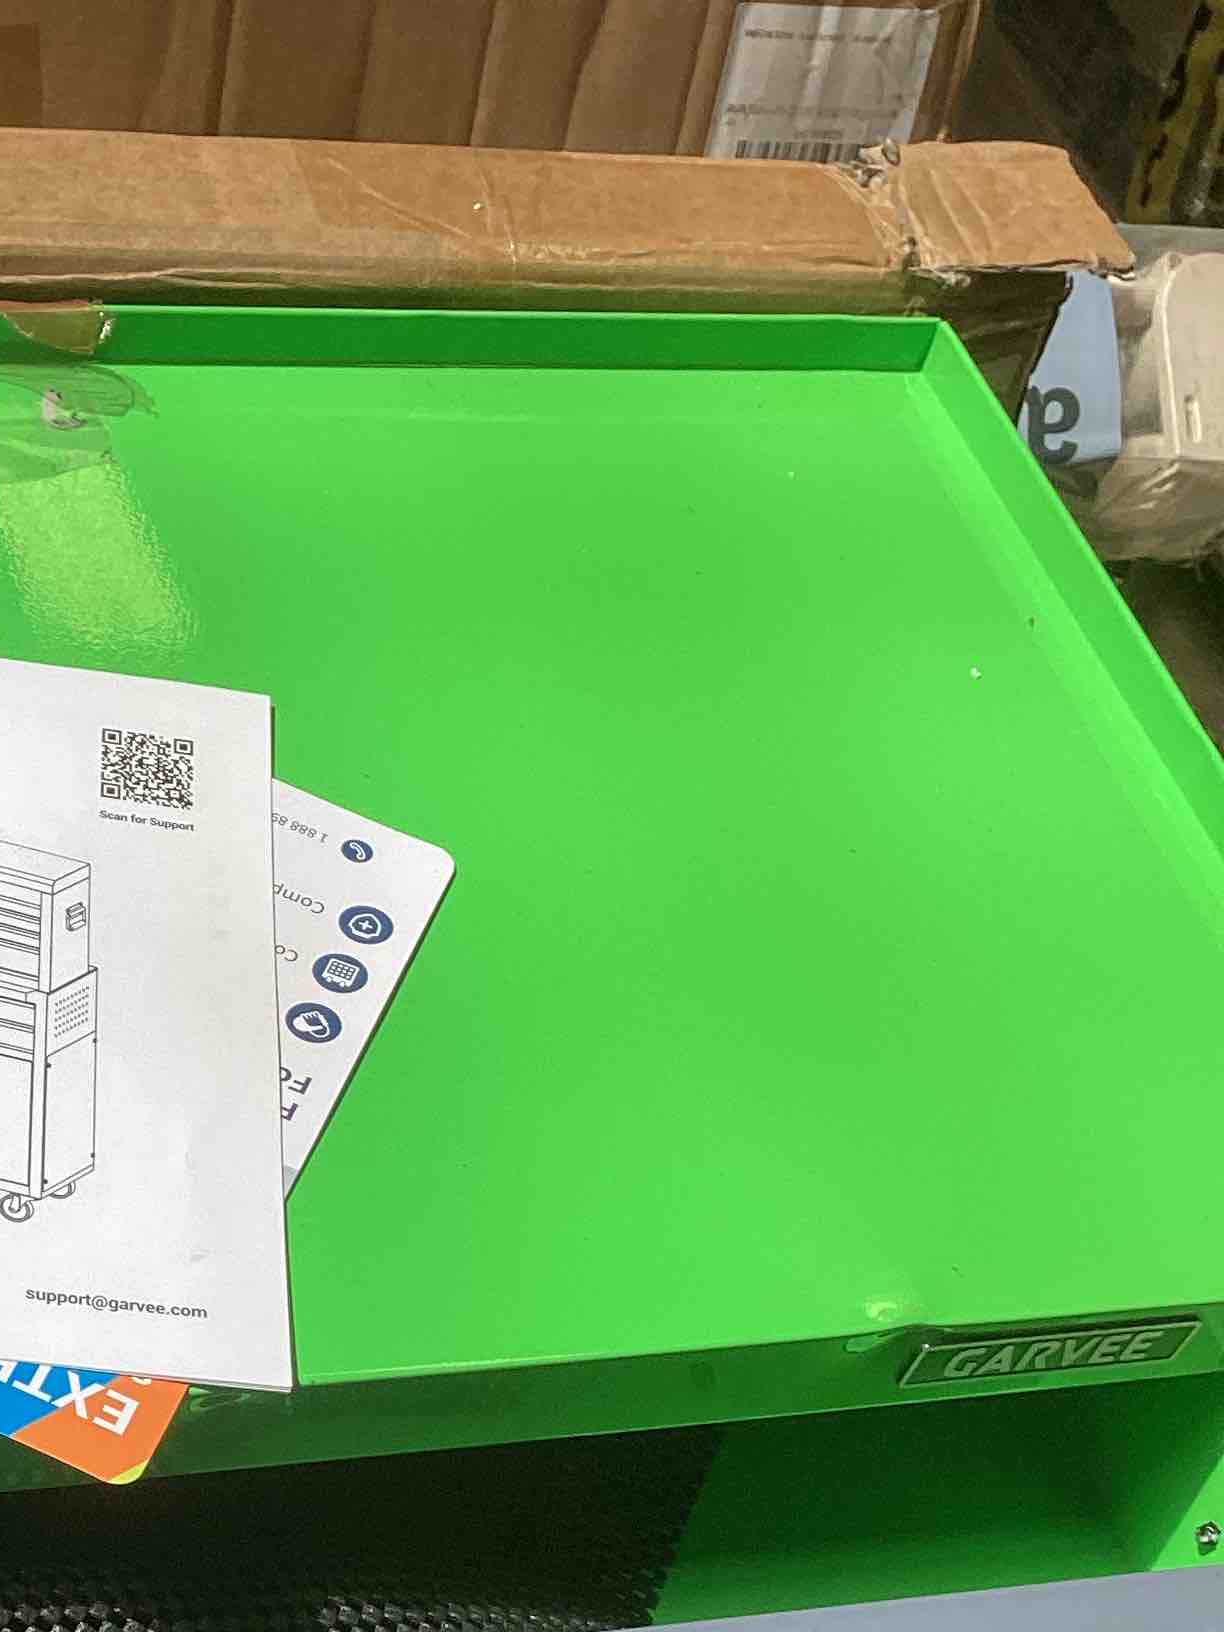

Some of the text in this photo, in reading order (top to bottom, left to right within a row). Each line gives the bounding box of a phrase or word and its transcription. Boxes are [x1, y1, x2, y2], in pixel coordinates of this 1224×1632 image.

[99, 809, 194, 831] Scan for Support
[289, 820, 318, 838] 888
[25, 1288, 208, 1319] support@garvee.com
[942, 1330, 1166, 1378] GARVEE
